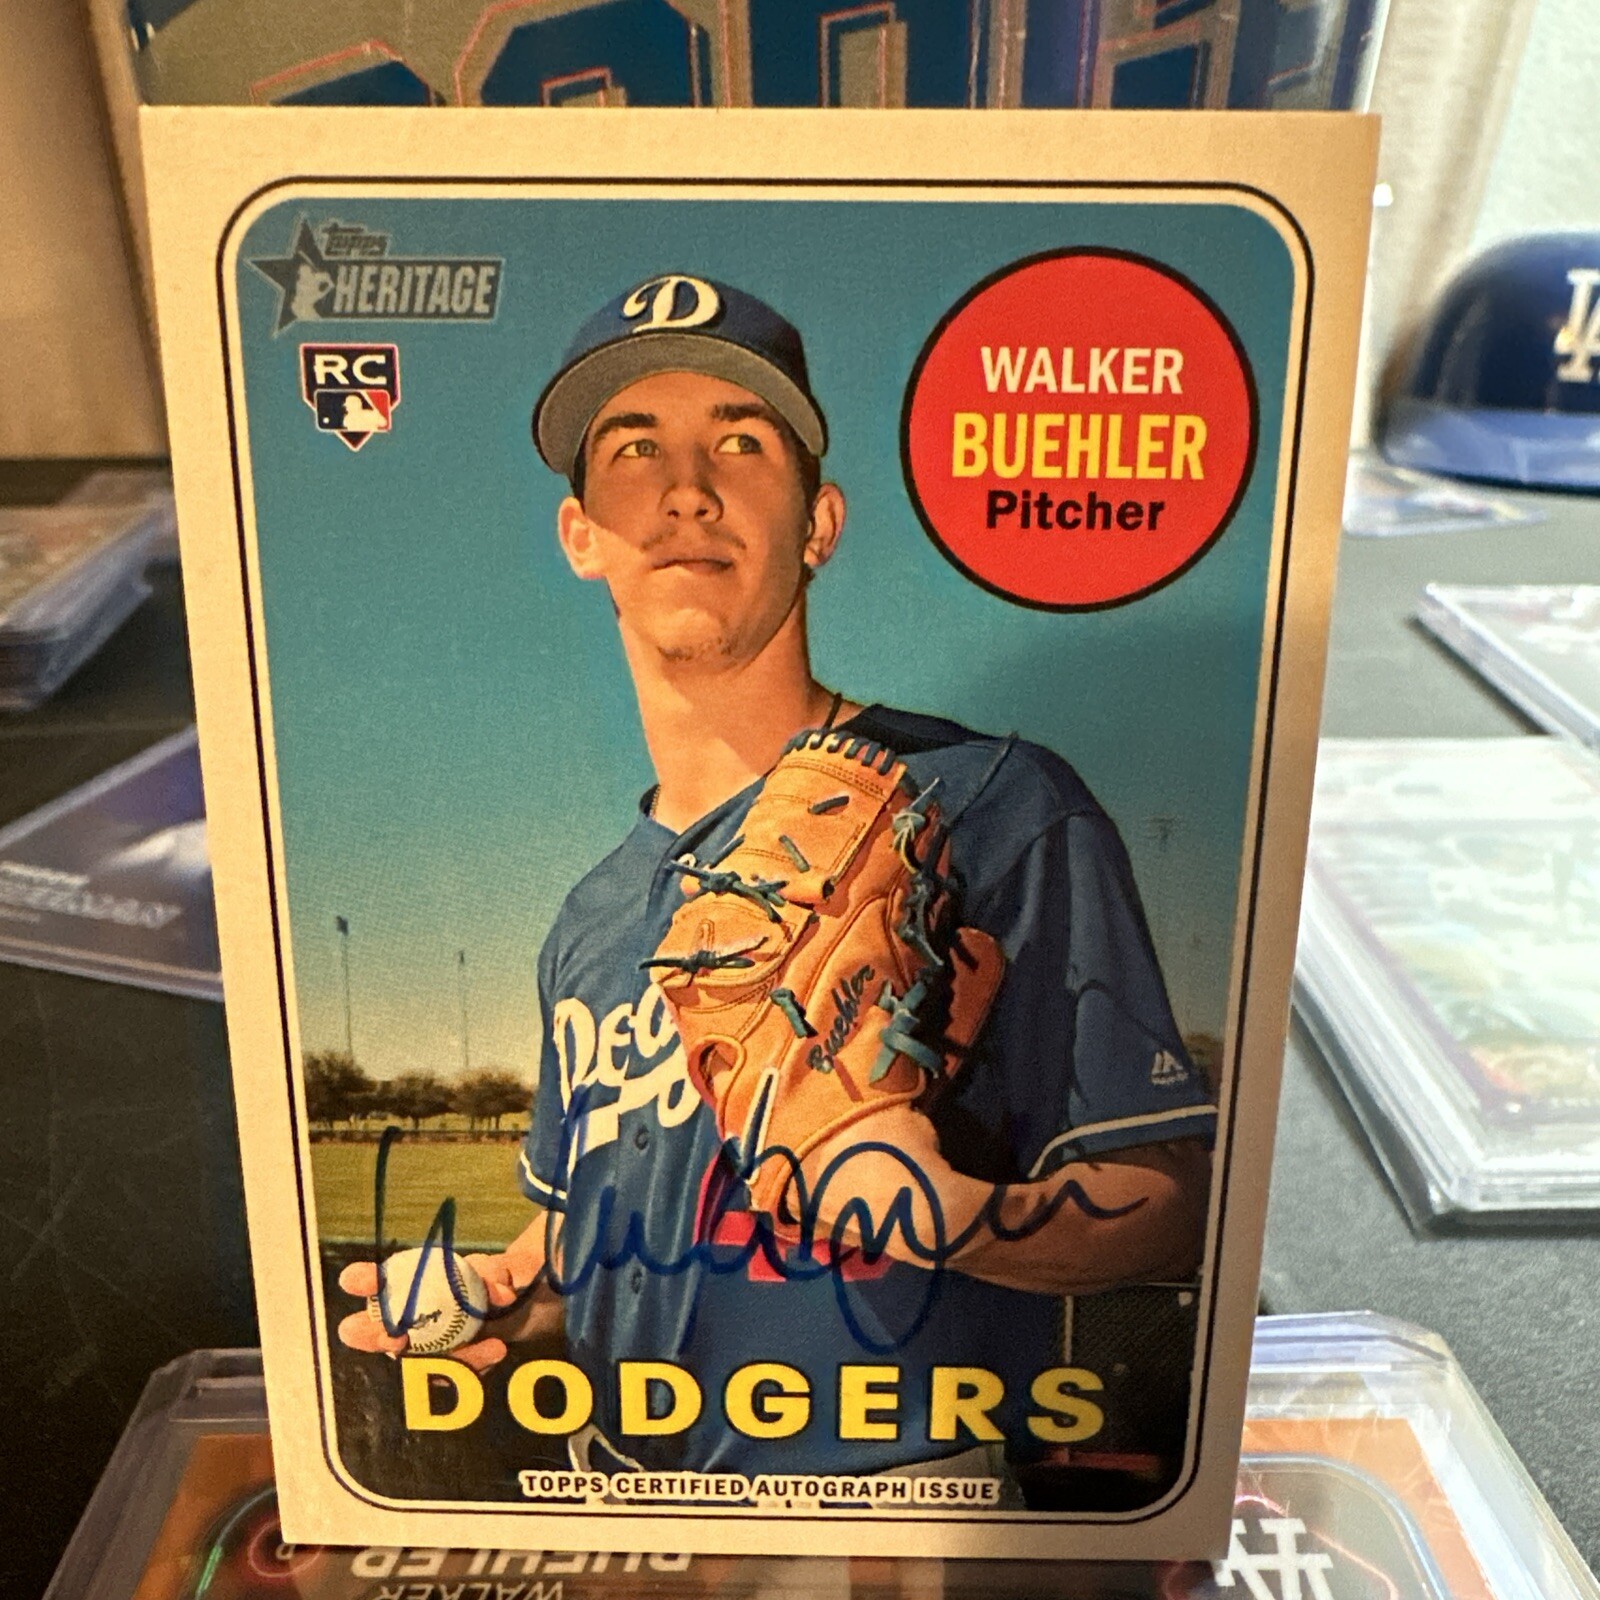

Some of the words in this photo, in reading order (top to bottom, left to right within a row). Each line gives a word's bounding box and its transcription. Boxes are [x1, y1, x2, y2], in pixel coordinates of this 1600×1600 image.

[333, 264, 496, 315] HERITAGE
[622, 275, 720, 334] D
[313, 354, 388, 386] RC
[980, 346, 1184, 395] WALKER
[951, 412, 1208, 481] BUEHLER
[985, 489, 1166, 532] Pitcher
[402, 1356, 1106, 1443] DODGERS
[525, 1475, 604, 1493] TOPPS
[616, 1477, 744, 1496] CERTIFIED
[755, 1480, 907, 1499] AUTOGRAPH
[919, 1482, 995, 1499] ISSUE
